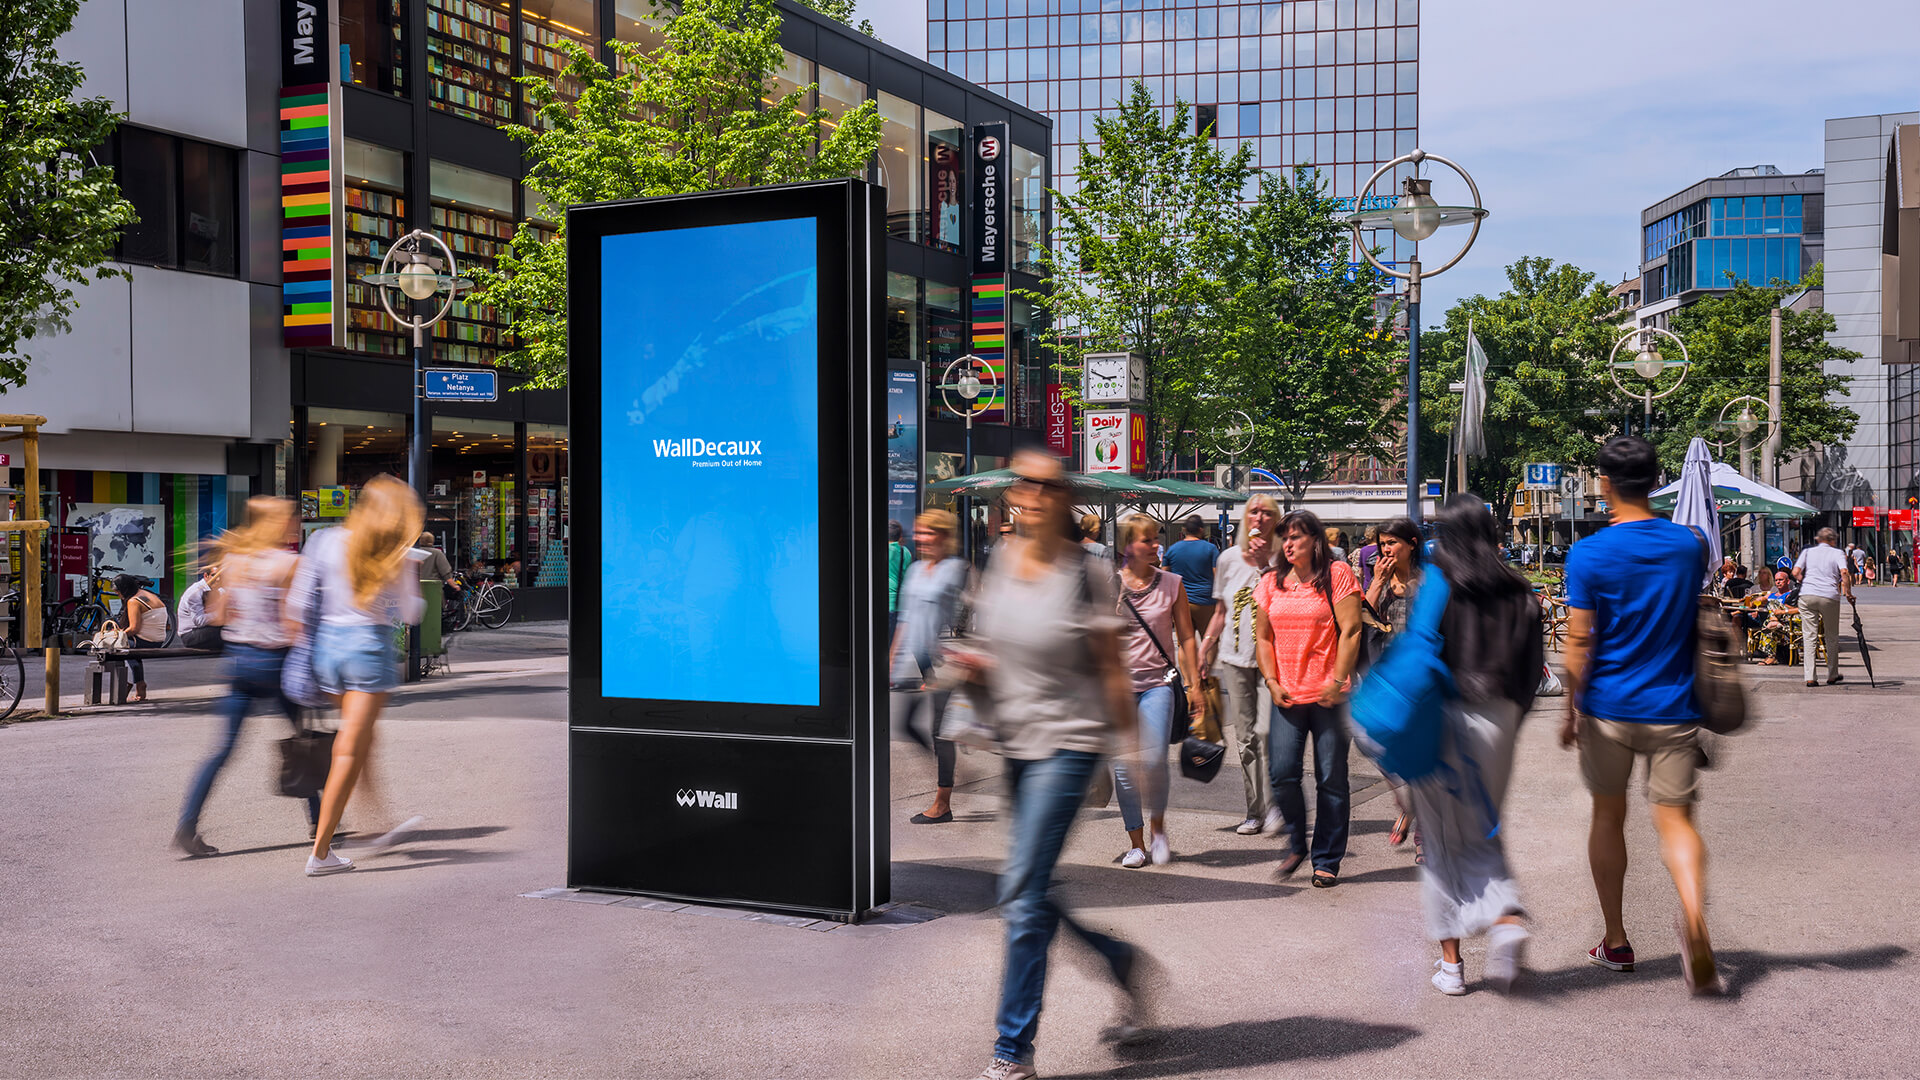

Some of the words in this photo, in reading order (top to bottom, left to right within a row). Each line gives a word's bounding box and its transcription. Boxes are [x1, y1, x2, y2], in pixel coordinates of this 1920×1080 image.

[293, 0, 317, 65] May
[982, 140, 995, 158] M
[981, 165, 997, 262] Mayersche
[446, 384, 474, 392] Netanya
[1051, 392, 1065, 448] ESPRIT
[1092, 415, 1122, 429] Daily
[652, 438, 762, 457] WallDecaux
[721, 459, 733, 467] Out
[735, 459, 741, 467] of
[743, 459, 762, 467] Home
[695, 790, 738, 810] Wall
